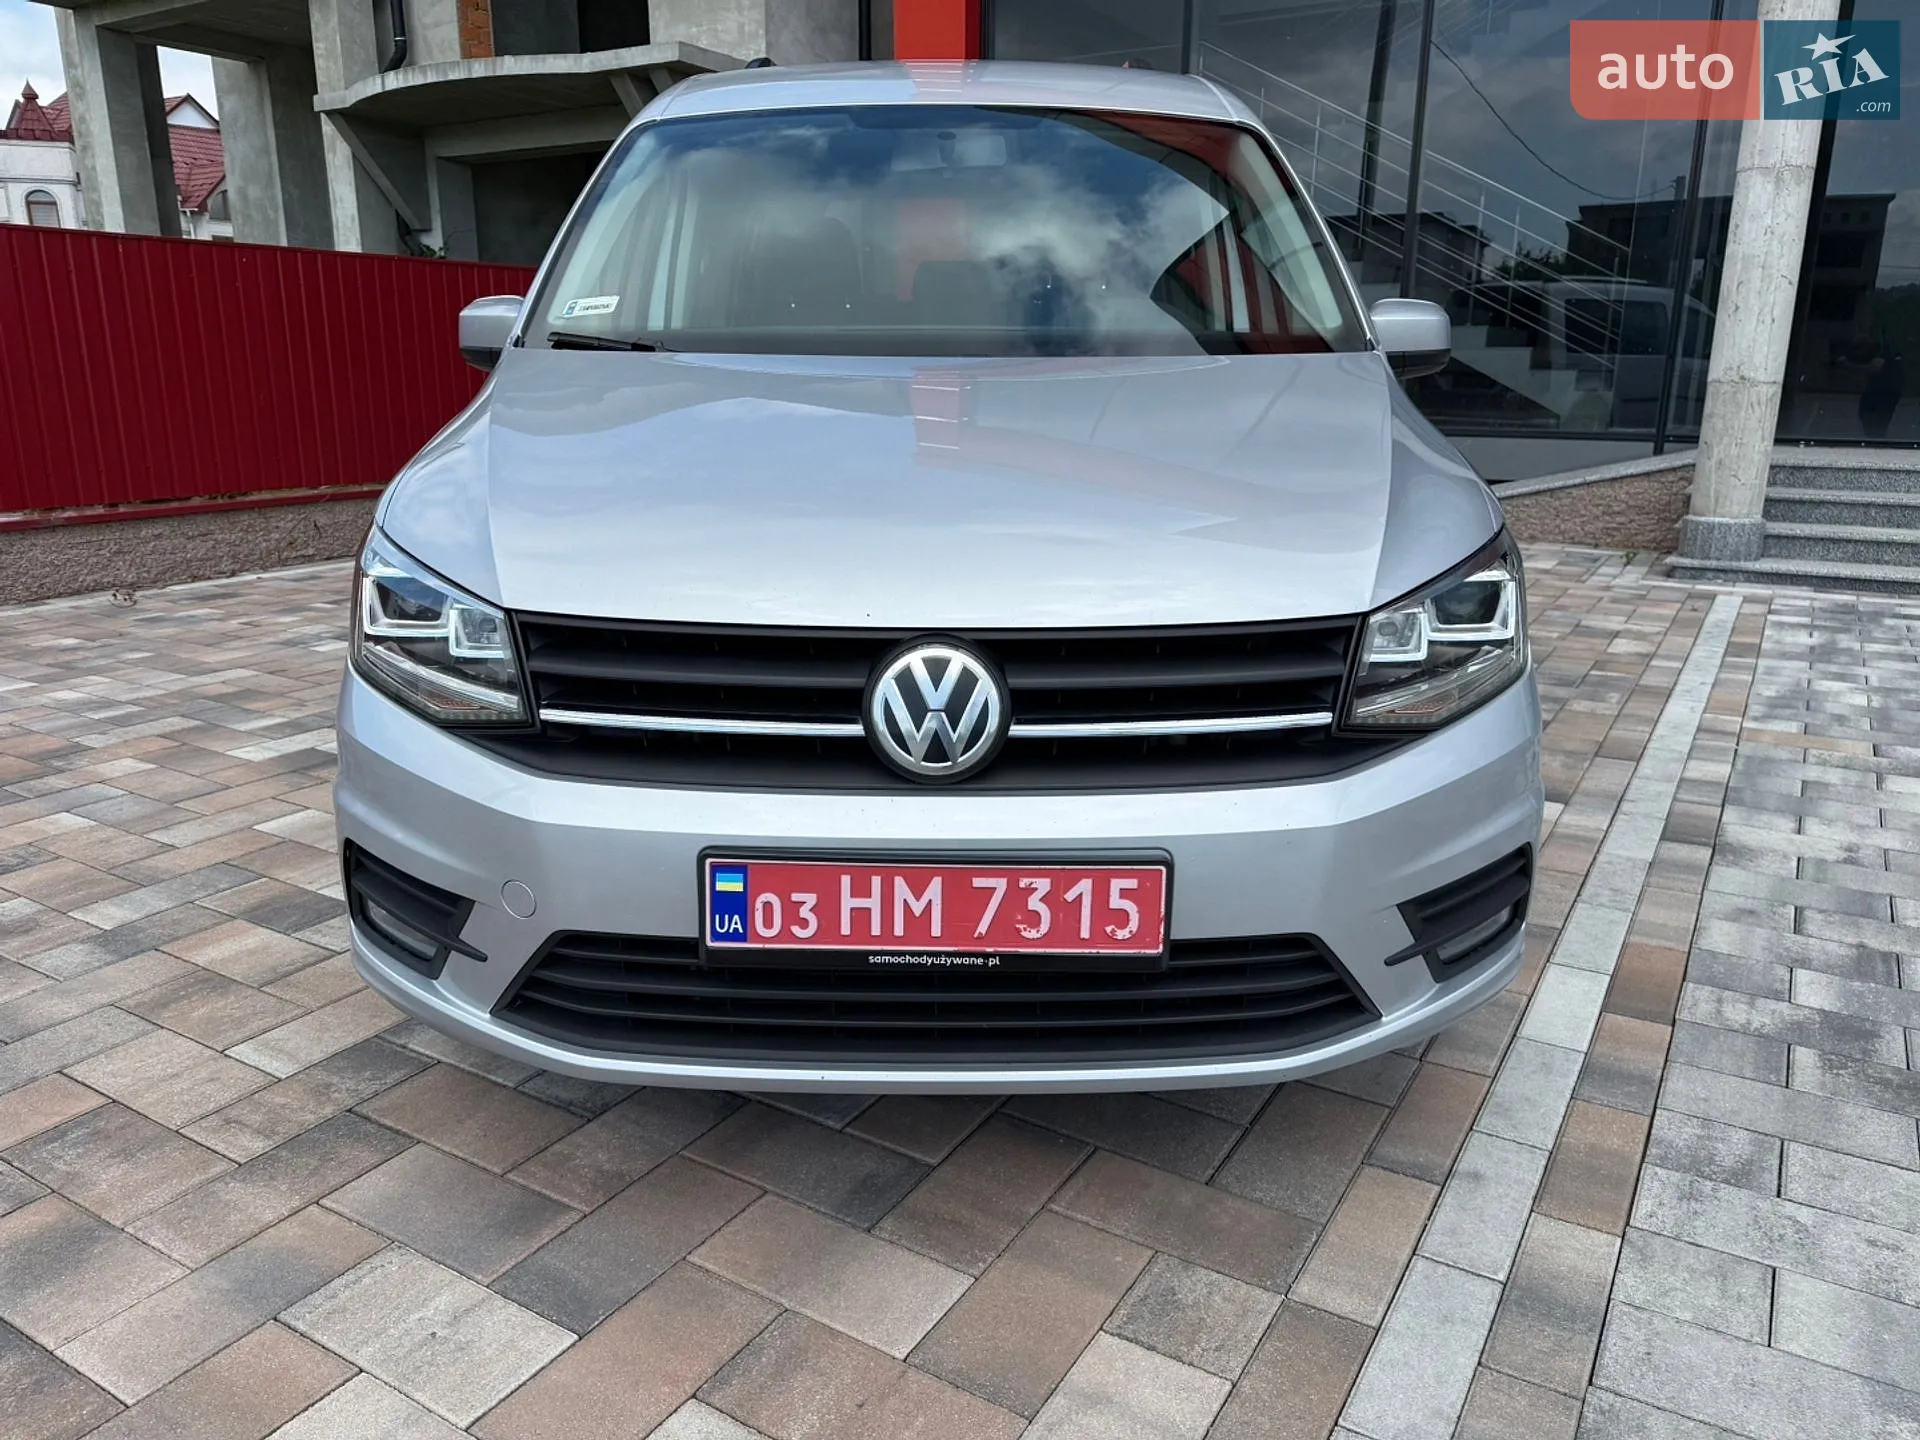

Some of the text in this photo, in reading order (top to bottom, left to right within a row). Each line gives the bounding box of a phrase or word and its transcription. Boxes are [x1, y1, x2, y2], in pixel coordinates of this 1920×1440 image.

[715, 914, 744, 934] UA
[754, 874, 1140, 940] 03 HM 7315
